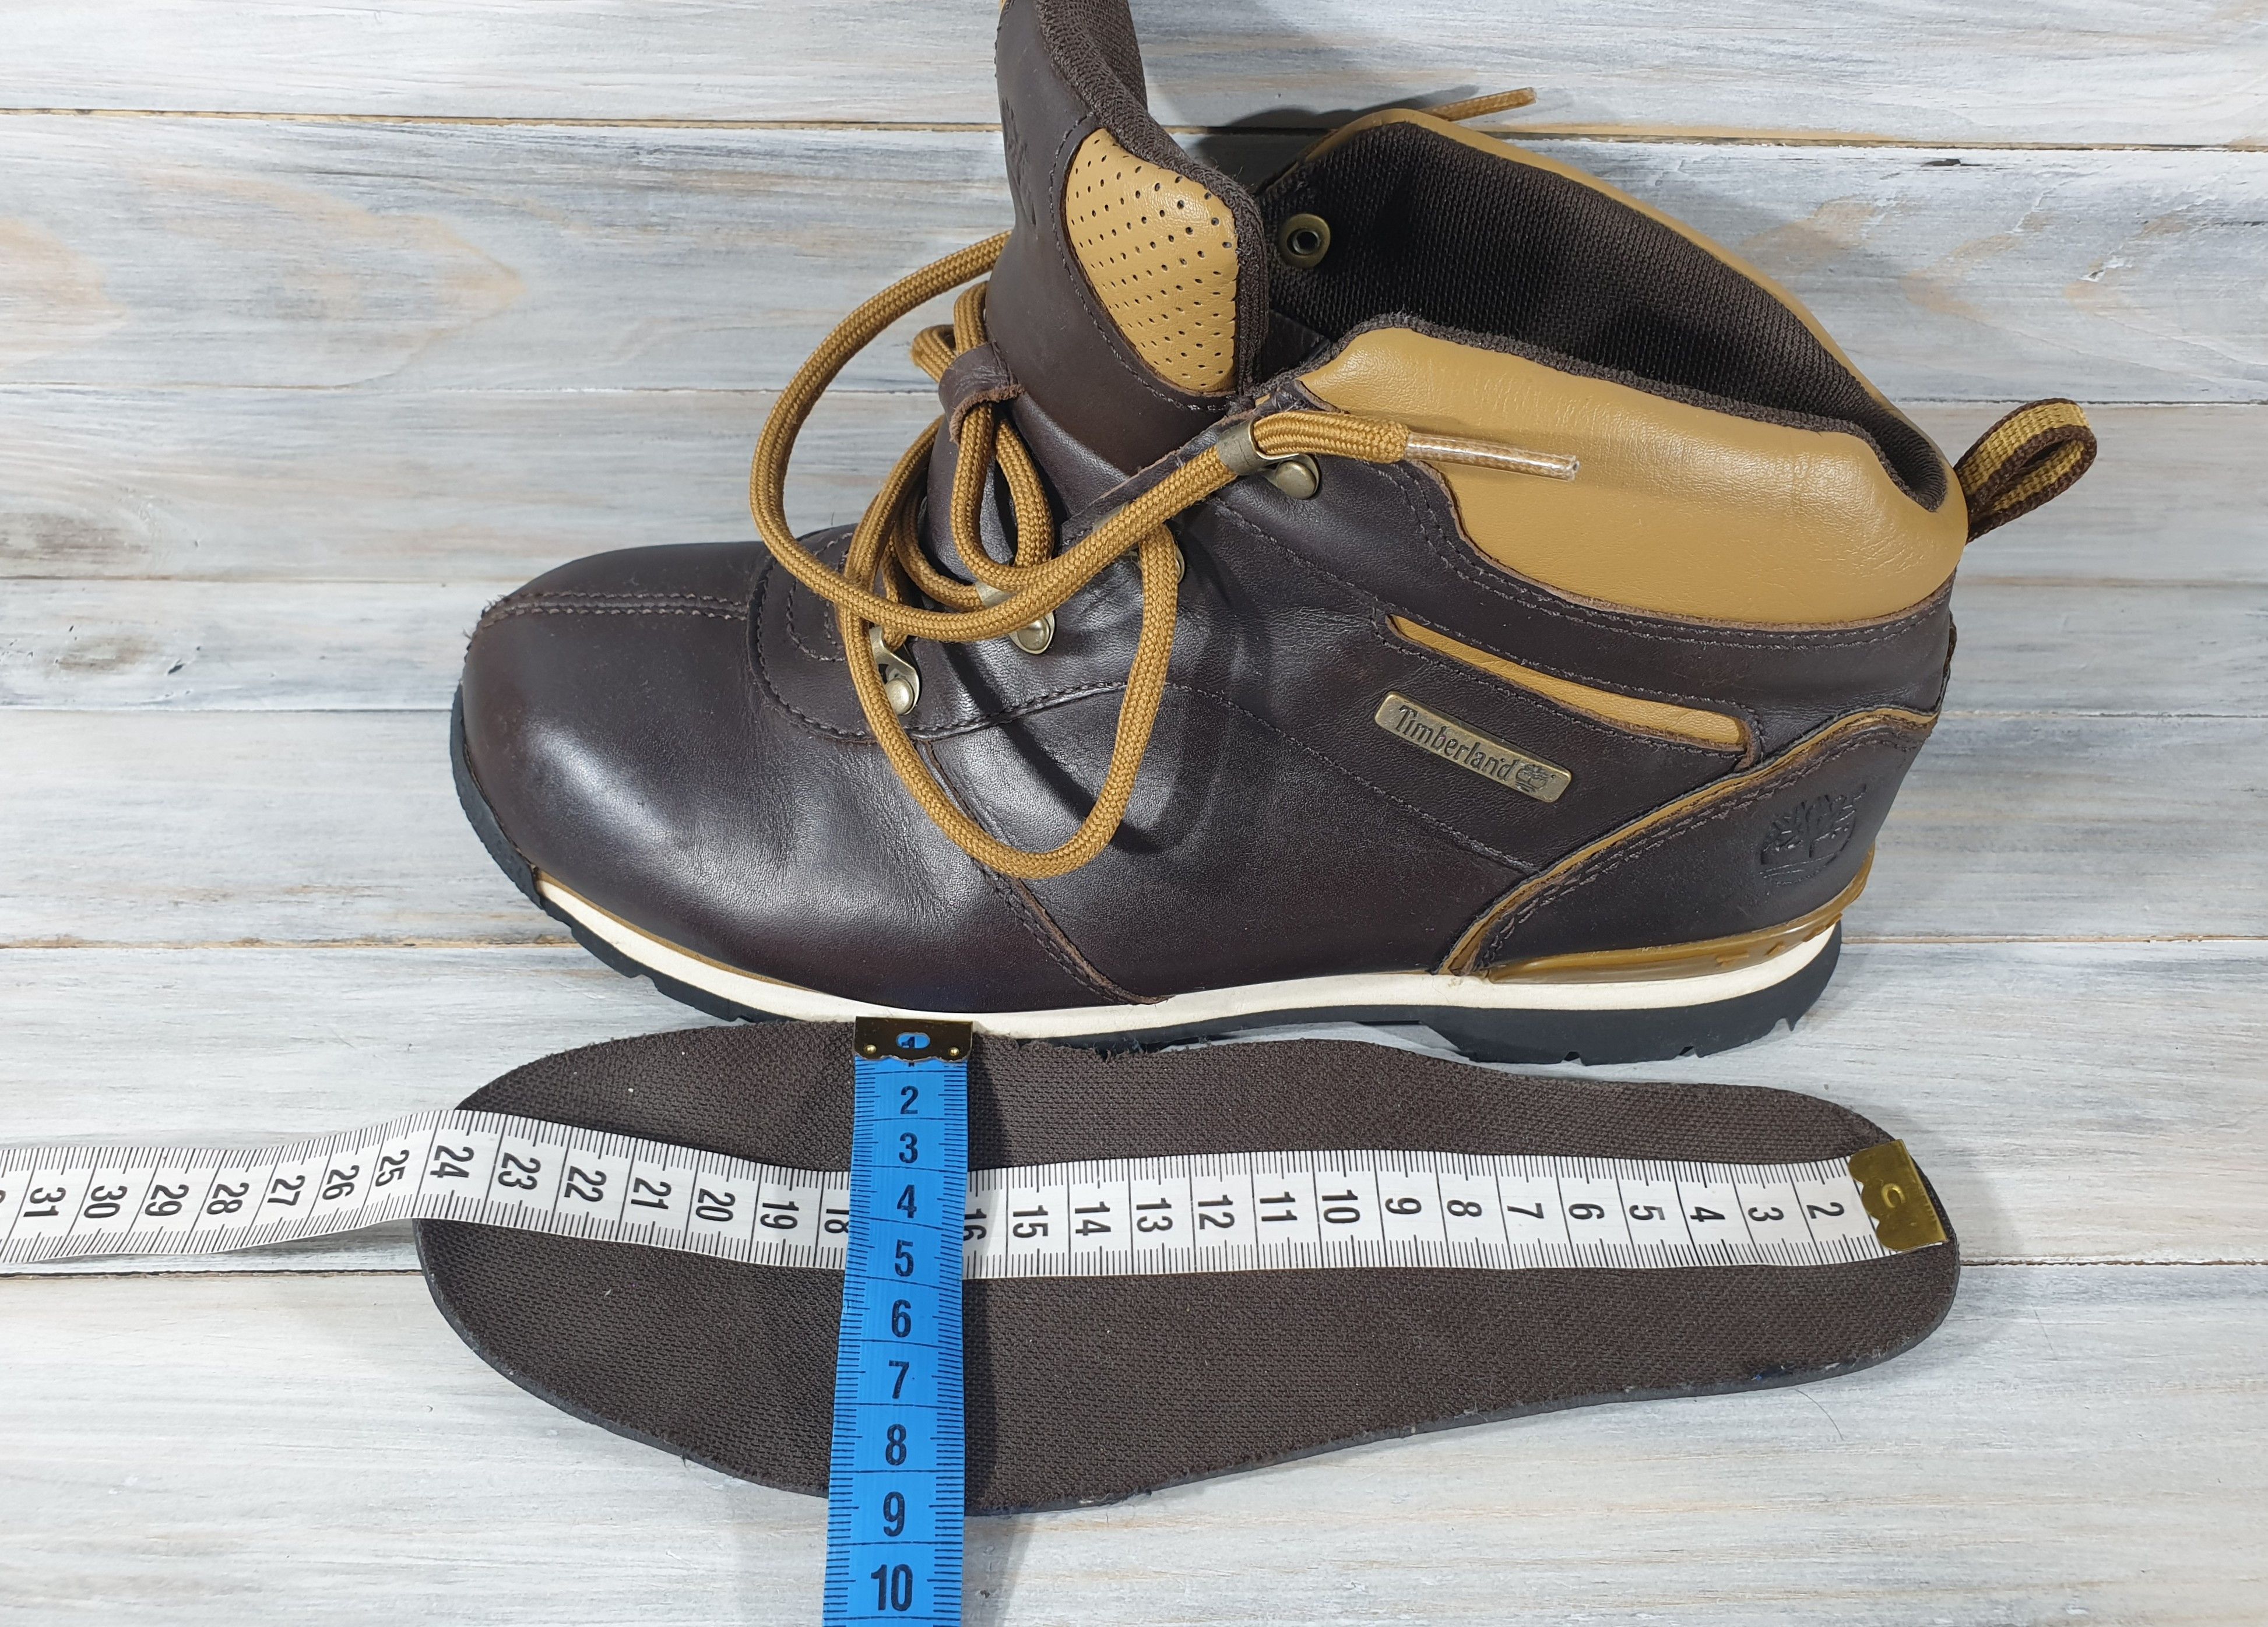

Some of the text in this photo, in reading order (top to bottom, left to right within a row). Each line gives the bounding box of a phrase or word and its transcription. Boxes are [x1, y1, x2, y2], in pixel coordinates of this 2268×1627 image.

[1393, 704, 1518, 782] Timberland
[900, 1085, 919, 1115] 2
[430, 1145, 474, 1178] 24
[899, 1132, 918, 1164] 3
[322, 1165, 360, 1200] 26
[375, 1149, 410, 1187] 25
[498, 1152, 541, 1190] 23
[564, 1165, 607, 1202] 22
[23, 1187, 66, 1217] 31
[83, 1185, 128, 1219] 30
[145, 1184, 189, 1216] 29
[206, 1182, 249, 1215] 28
[267, 1175, 305, 1206] 27
[630, 1177, 671, 1210] 21
[695, 1188, 736, 1222] 20
[896, 1185, 917, 1219] 4
[1260, 1191, 1297, 1222] 11
[1321, 1189, 1360, 1224] 10
[1385, 1198, 1422, 1215] 9
[759, 1200, 800, 1230] 19
[824, 1208, 849, 1234] 18
[964, 1207, 987, 1241] 16
[1012, 1205, 1048, 1238] 15
[1074, 1201, 1112, 1236] 14
[1136, 1198, 1173, 1232] 13
[1198, 1195, 1235, 1230] 12
[1447, 1199, 1482, 1217] 8
[1507, 1203, 1544, 1219] 7
[1569, 1203, 1605, 1220] 6
[1629, 1205, 1665, 1221] 5
[1690, 1206, 1726, 1223] 4
[1747, 1207, 1784, 1222] 3
[1806, 1202, 1845, 1219] 2
[895, 1239, 914, 1277] 5
[891, 1300, 912, 1338] 6
[888, 1361, 909, 1399] 7
[885, 1424, 907, 1466] 8
[883, 1492, 905, 1537] 9
[871, 1564, 913, 1611] 10
